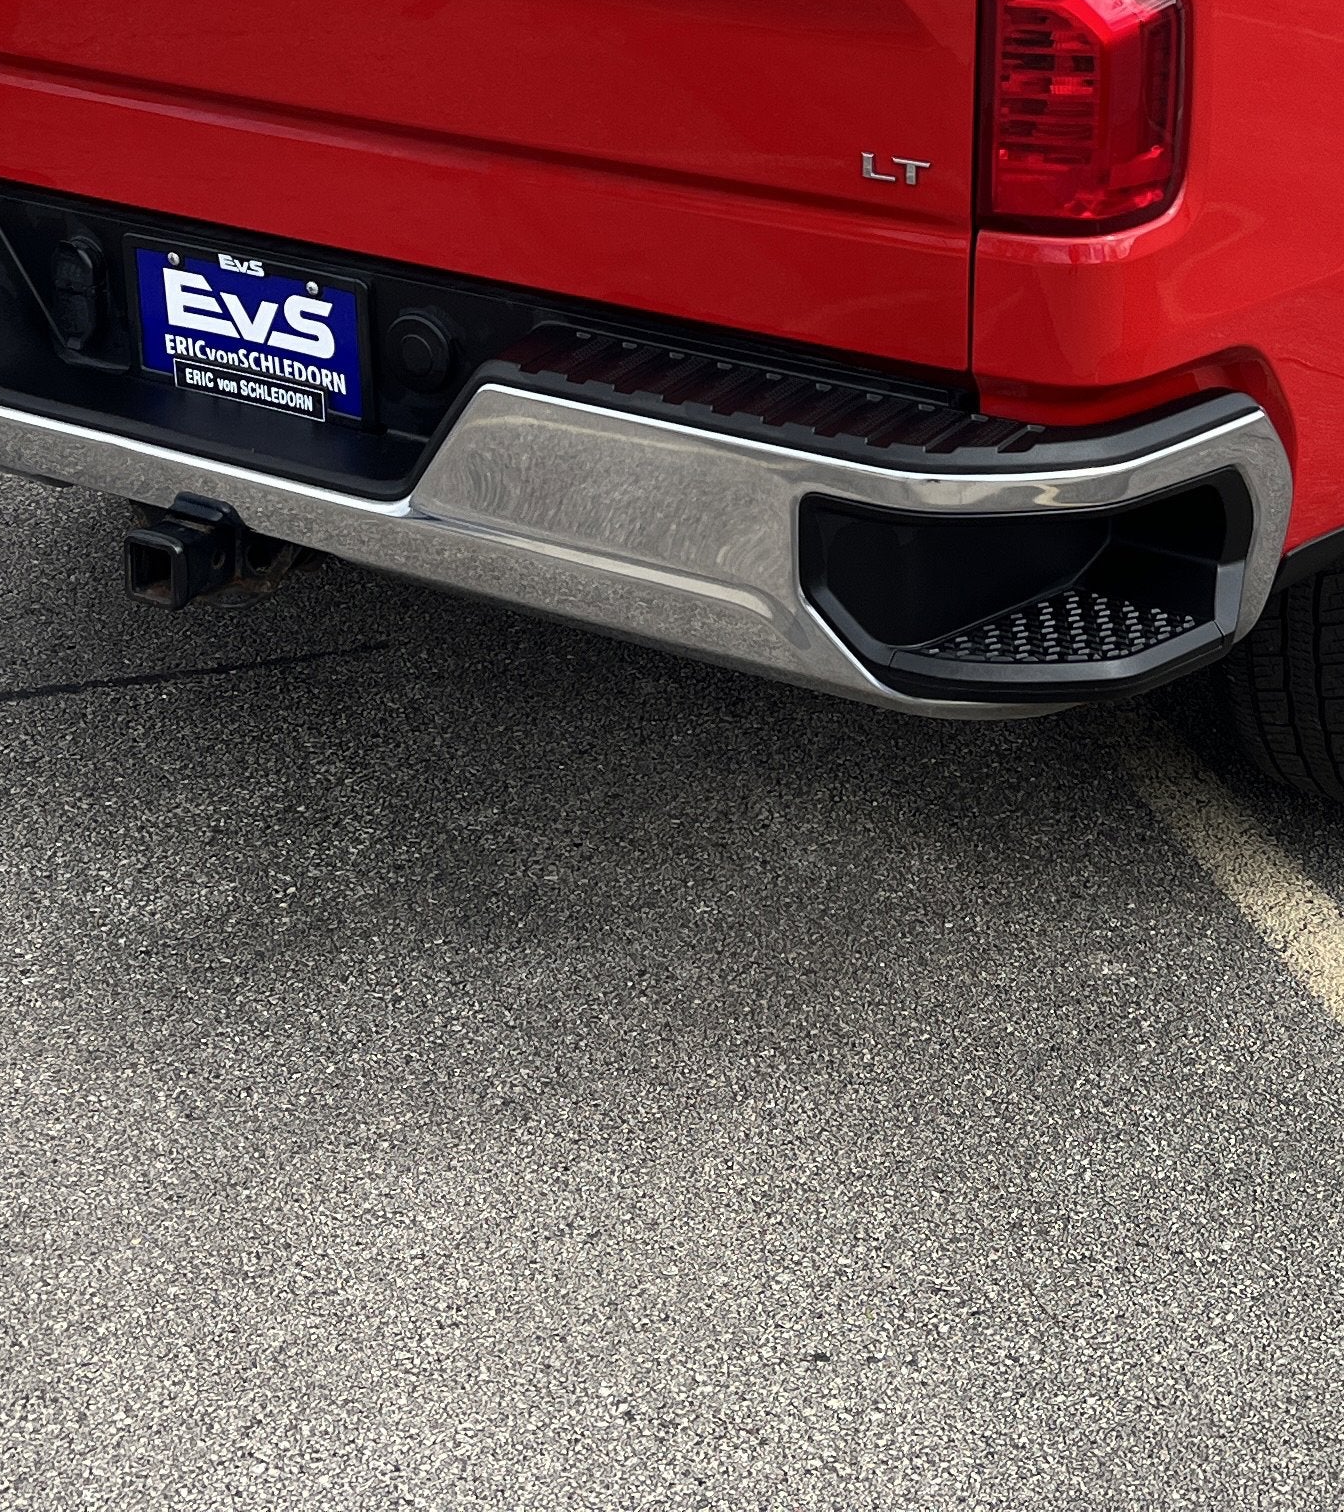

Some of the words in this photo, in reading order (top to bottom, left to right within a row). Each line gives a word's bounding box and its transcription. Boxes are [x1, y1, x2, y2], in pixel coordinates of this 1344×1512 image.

[861, 150, 931, 186] LT
[185, 368, 214, 388] ERIC
[217, 377, 238, 394] von
[239, 379, 313, 412] SCHLEDORN
